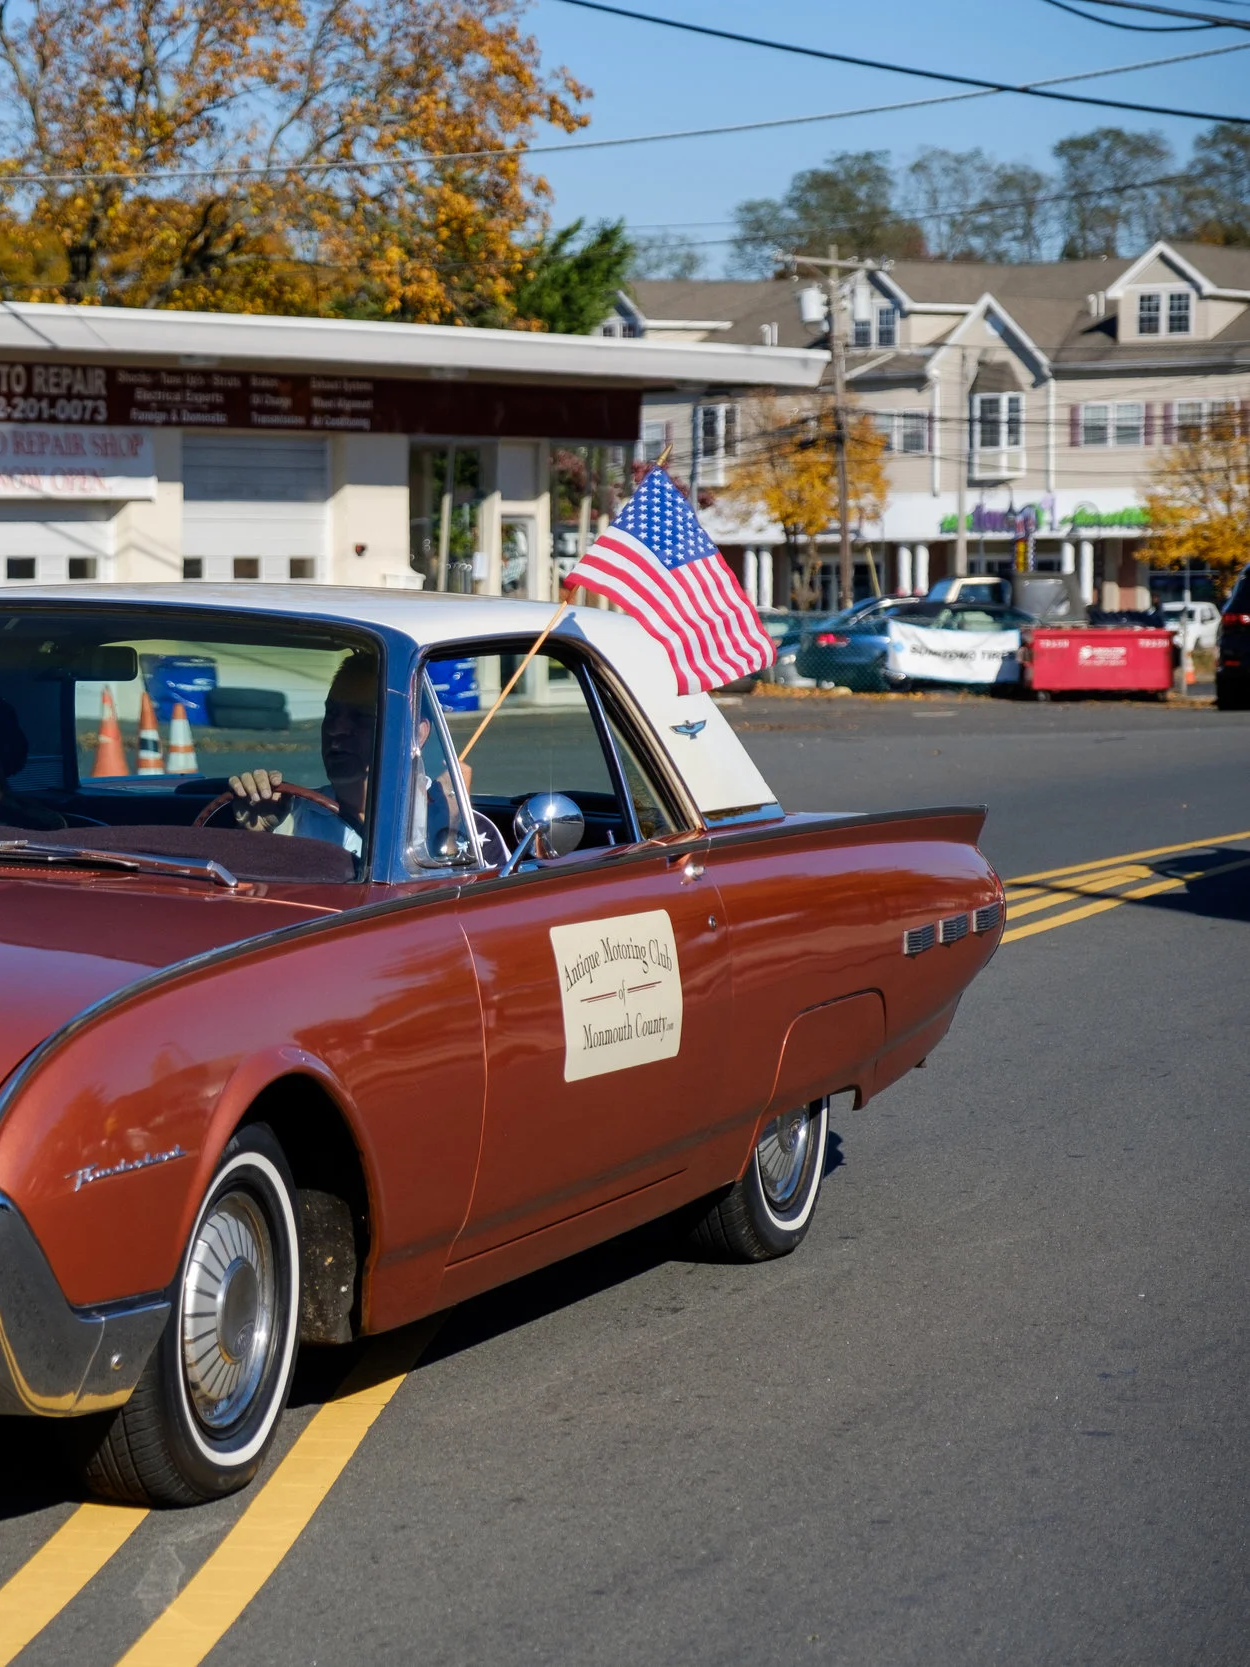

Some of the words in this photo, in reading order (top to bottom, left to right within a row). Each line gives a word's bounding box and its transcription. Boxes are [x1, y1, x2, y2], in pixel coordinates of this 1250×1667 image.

[32, 366, 107, 395] REPAIR
[13, 430, 87, 455] REPAIR
[91, 433, 144, 457] SHOP
[564, 950, 601, 993] Antique
[600, 937, 649, 974] Motoring
[648, 939, 673, 972] Club
[618, 978, 626, 1006] of
[583, 1013, 633, 1051] Monmouth
